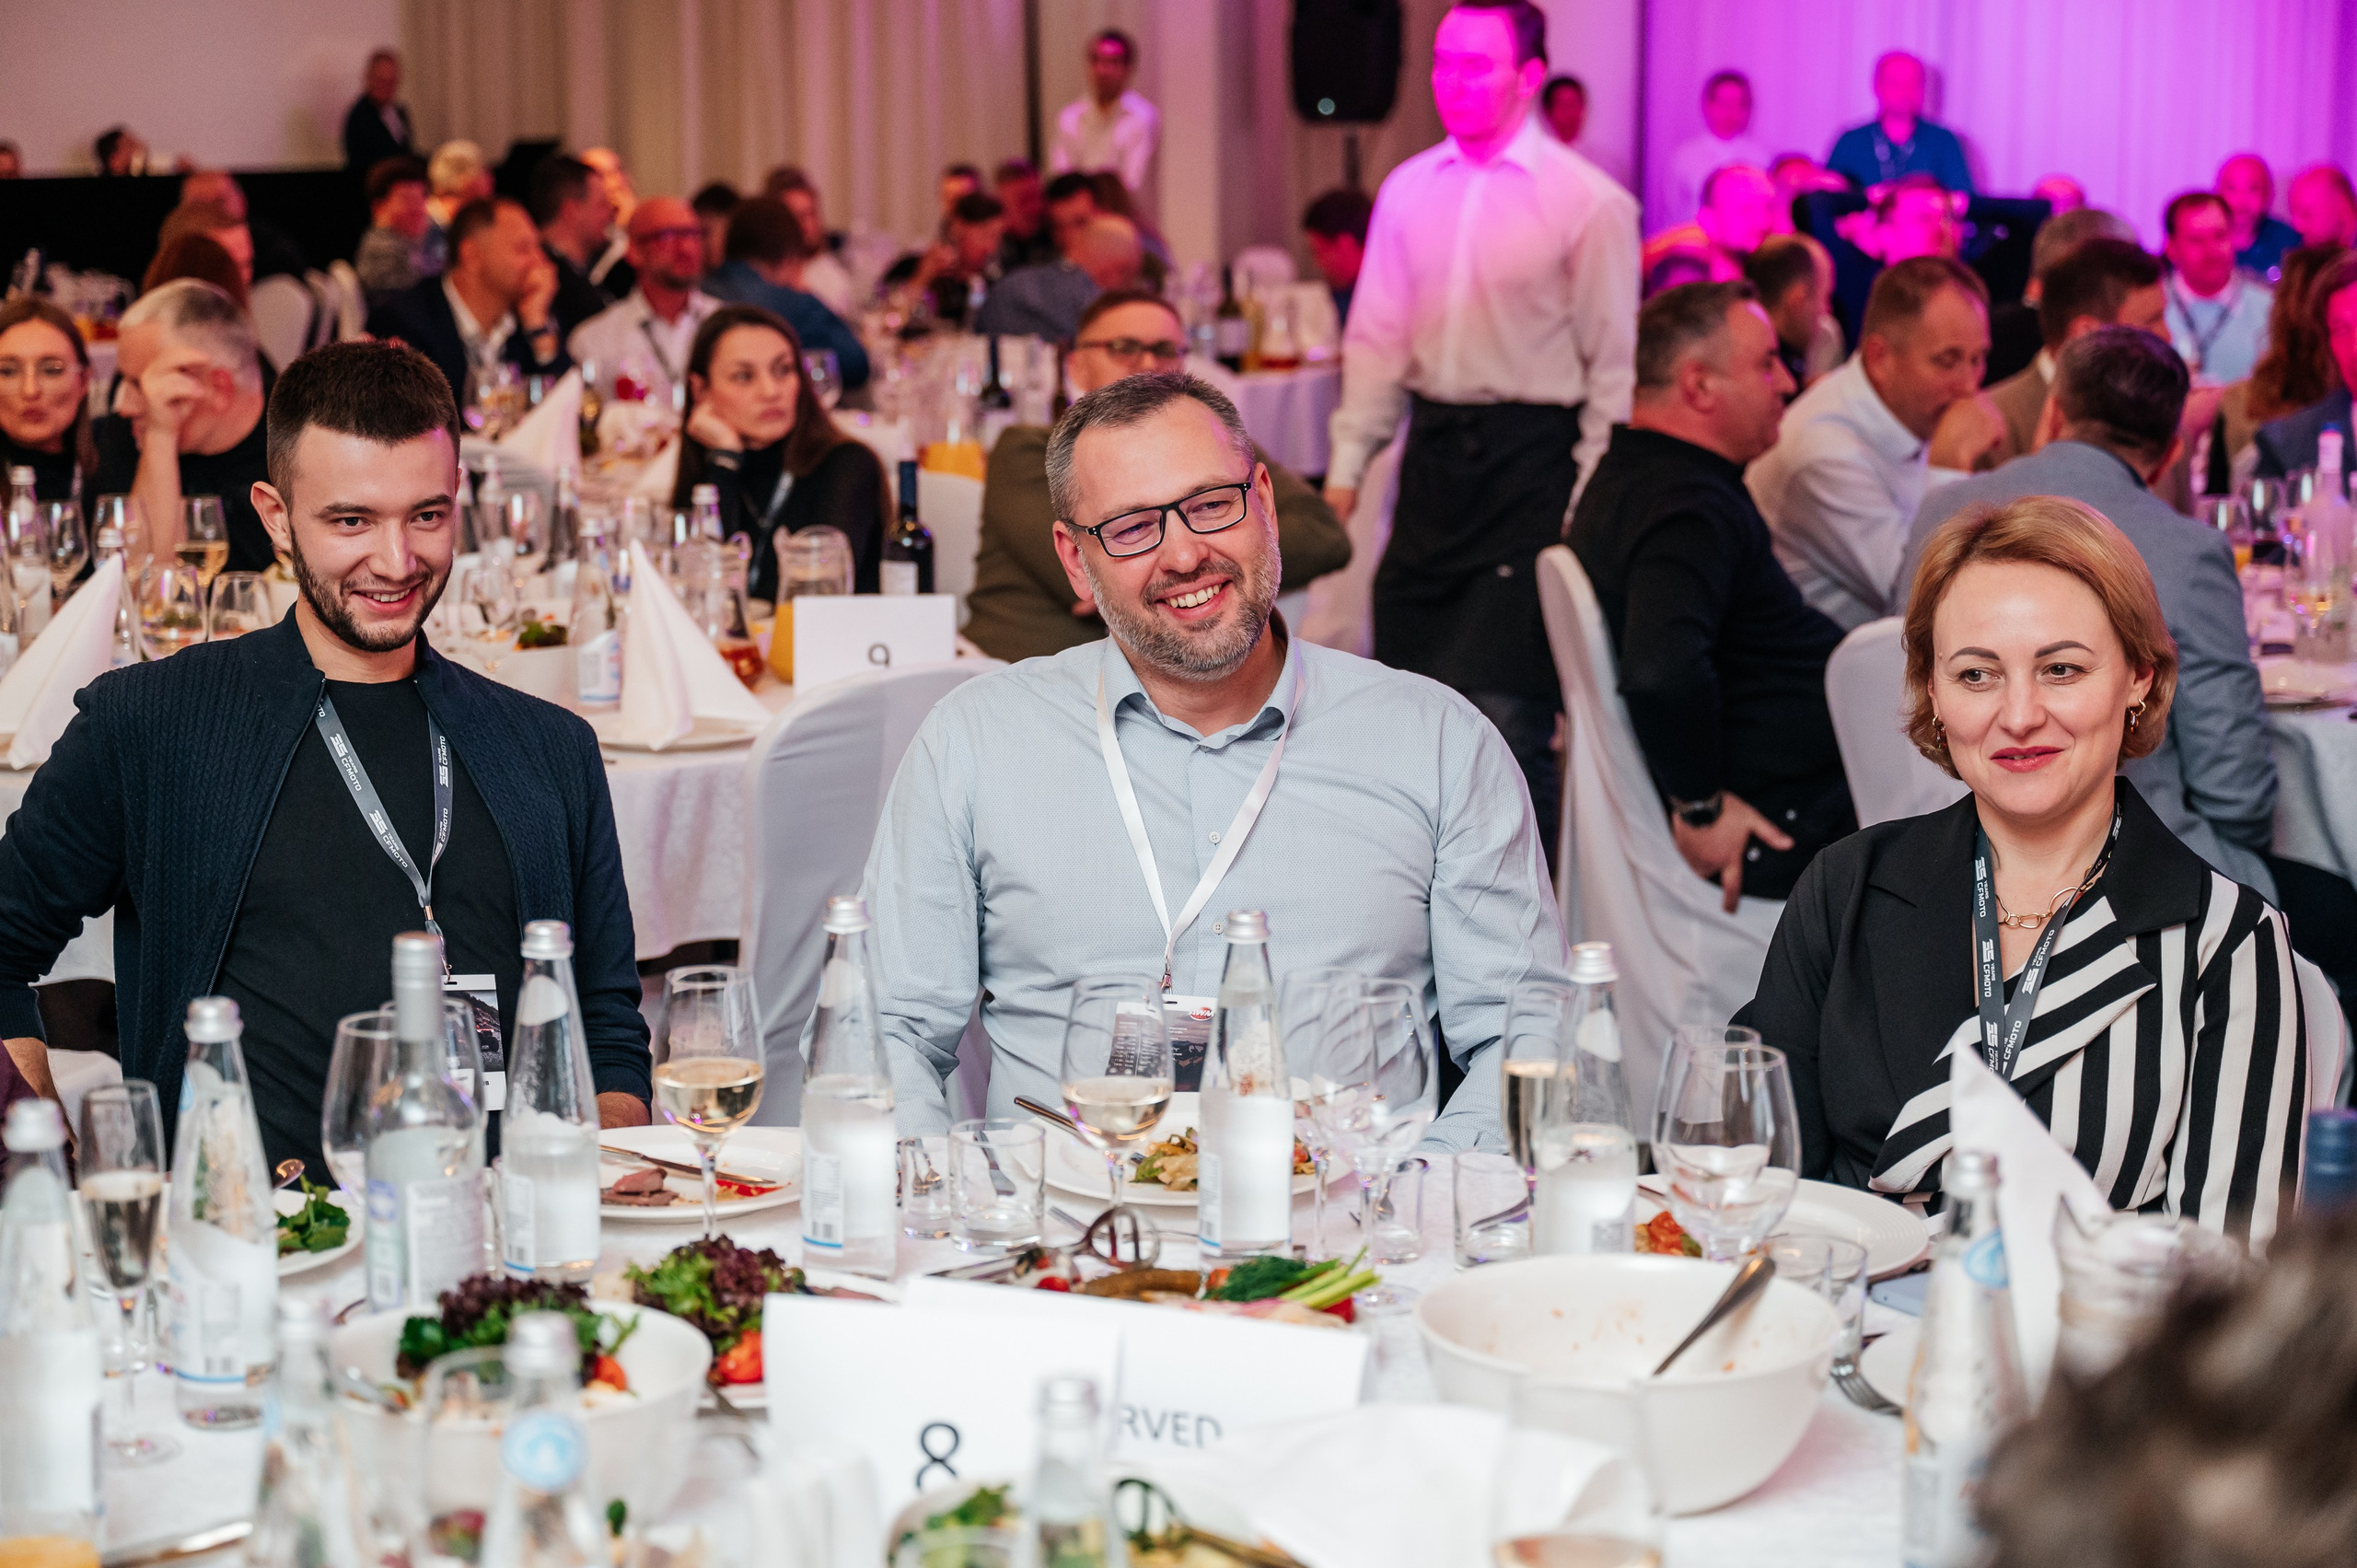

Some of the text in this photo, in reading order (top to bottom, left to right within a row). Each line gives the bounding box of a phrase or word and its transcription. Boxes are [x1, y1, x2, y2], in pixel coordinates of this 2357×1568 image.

[347, 756, 359, 773] YEARS
[439, 736, 448, 765] CFMOTO
[341, 758, 362, 791] CFMOTO
[382, 835, 408, 867] CFMOTO
[1977, 881, 1986, 918] CFMOTO
[2032, 946, 2043, 966] YEARS
[2036, 929, 2055, 967] CFMOTO
[1983, 963, 1991, 998] CFMOTO
[2003, 1019, 2022, 1061] CFMOTO
[916, 1422, 960, 1489] 8
